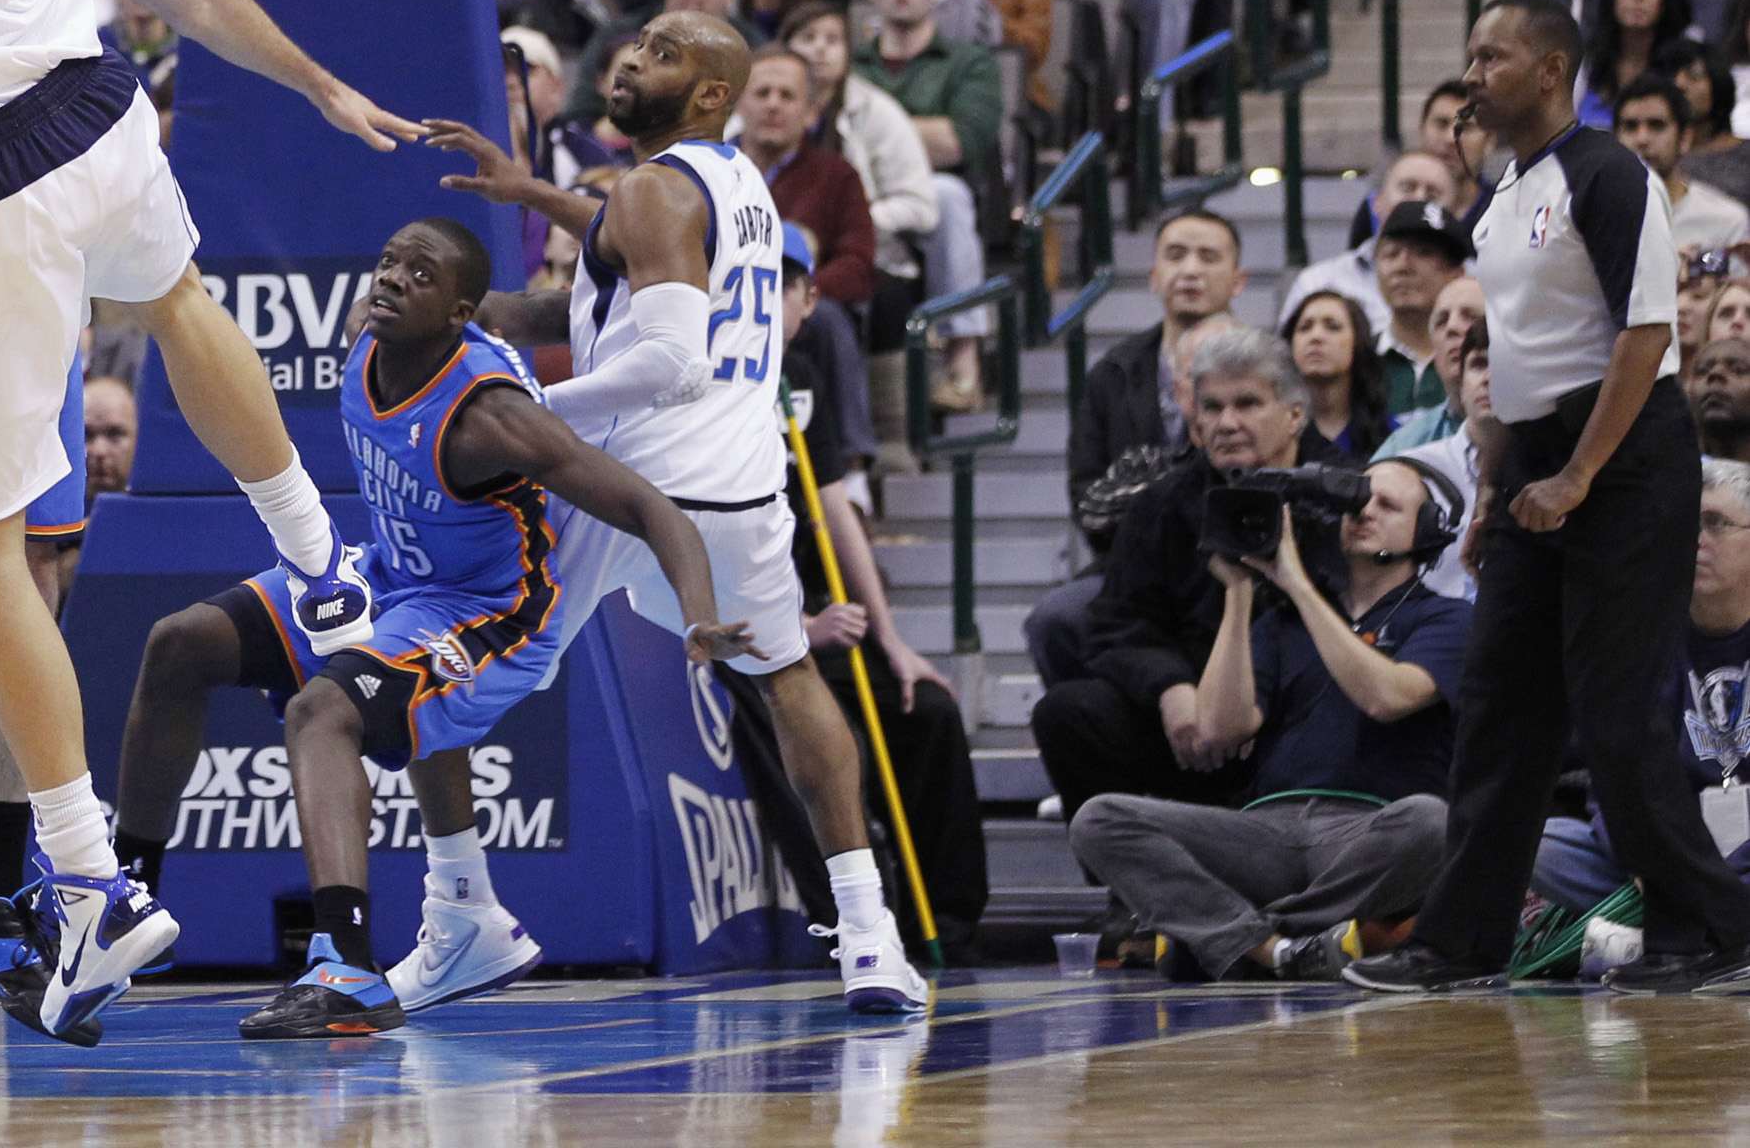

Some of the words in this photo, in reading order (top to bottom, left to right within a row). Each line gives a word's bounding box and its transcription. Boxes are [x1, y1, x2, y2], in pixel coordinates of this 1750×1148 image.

[707, 266, 778, 383] 25
[341, 418, 442, 513] LAHOMA
[377, 513, 434, 577] 15
[316, 597, 345, 620] NIKE
